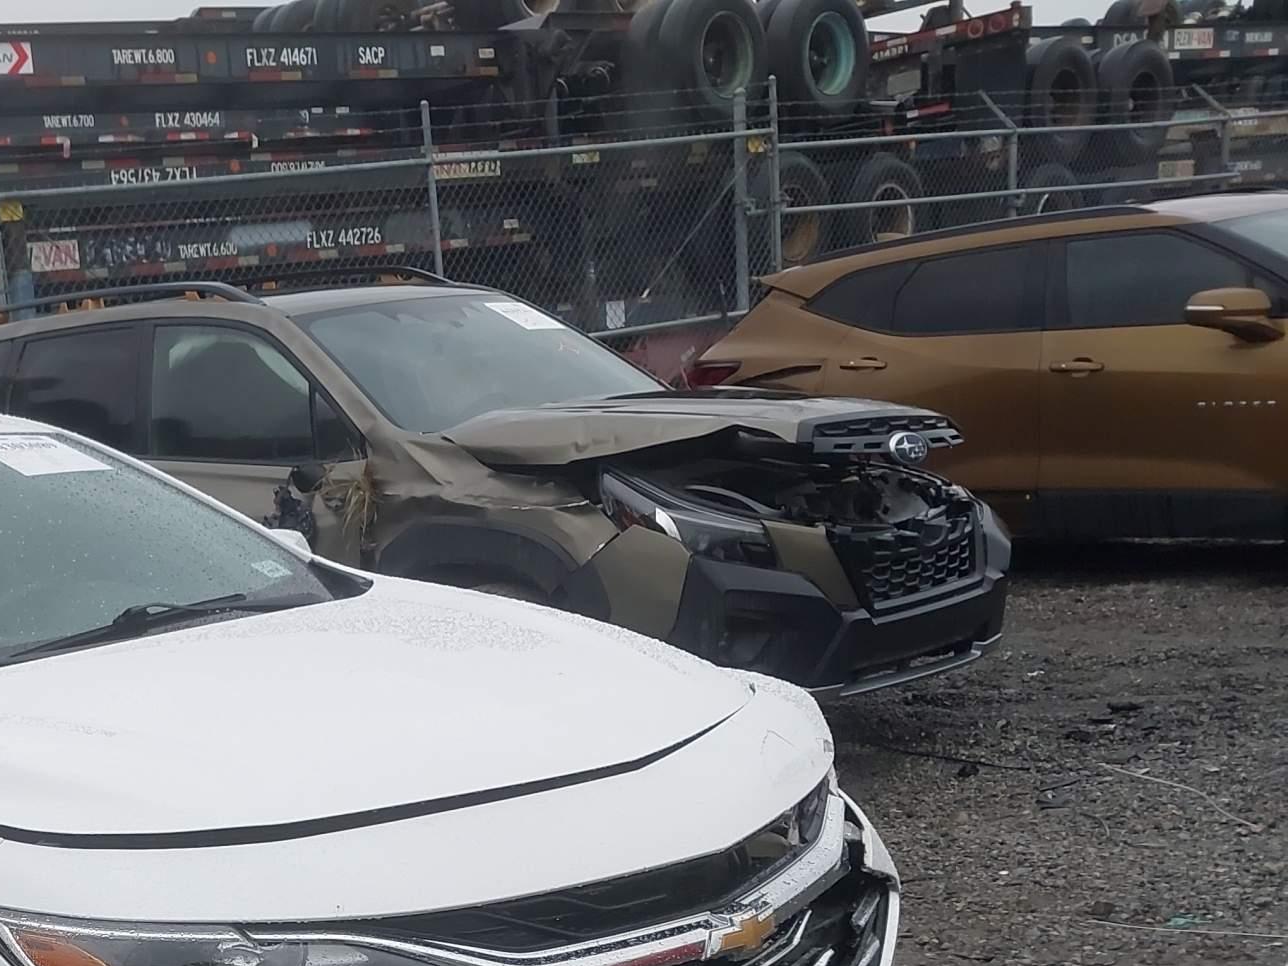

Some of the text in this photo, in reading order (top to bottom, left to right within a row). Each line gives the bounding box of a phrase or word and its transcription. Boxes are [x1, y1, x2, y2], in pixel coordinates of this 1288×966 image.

[246, 46, 317, 67] FLXZ 414671
[358, 46, 384, 65] SACP
[155, 112, 220, 128] FLXZ 430464
[306, 226, 382, 249] FLXZ 442726
